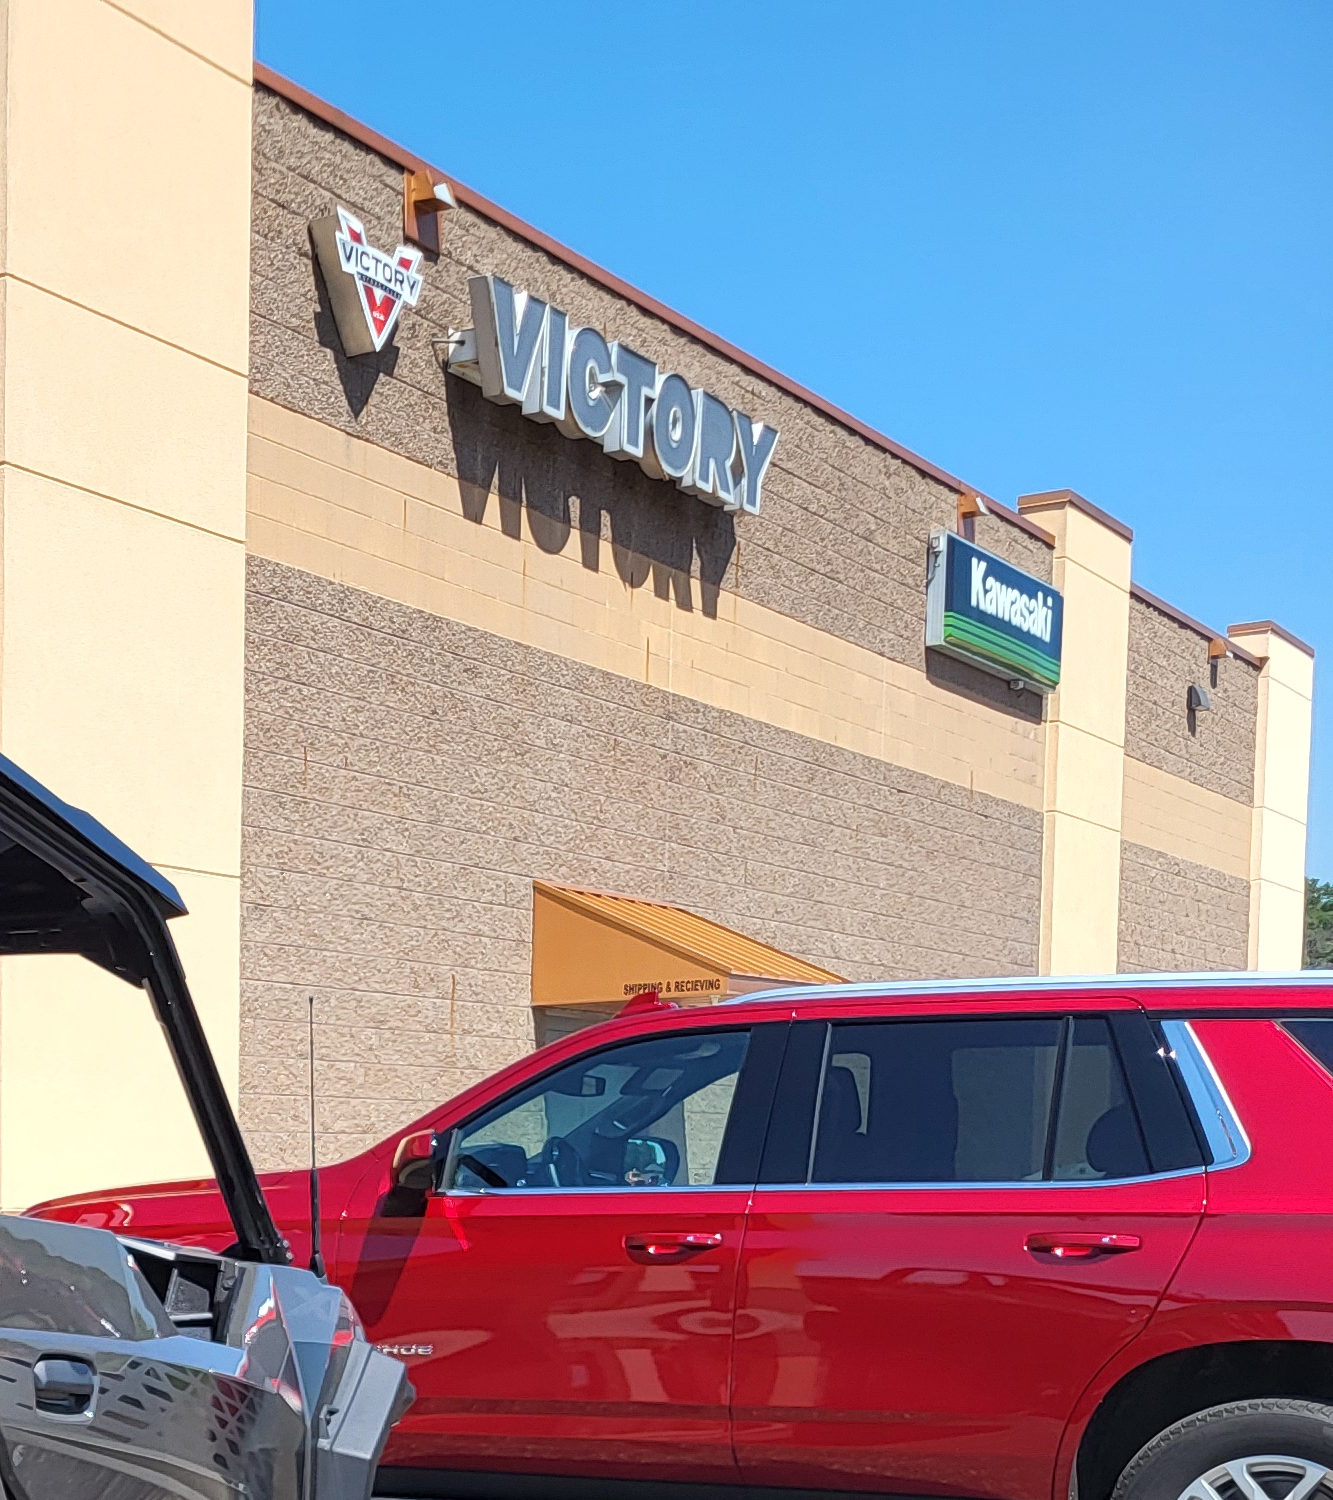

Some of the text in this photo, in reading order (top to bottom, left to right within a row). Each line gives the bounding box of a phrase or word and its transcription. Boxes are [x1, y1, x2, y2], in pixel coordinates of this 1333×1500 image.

[342, 242, 418, 296] VICTORY
[483, 273, 780, 516] VICTORY
[970, 556, 1053, 643] Kawasaki
[623, 978, 721, 995] SHIPPING & RECIEVING
